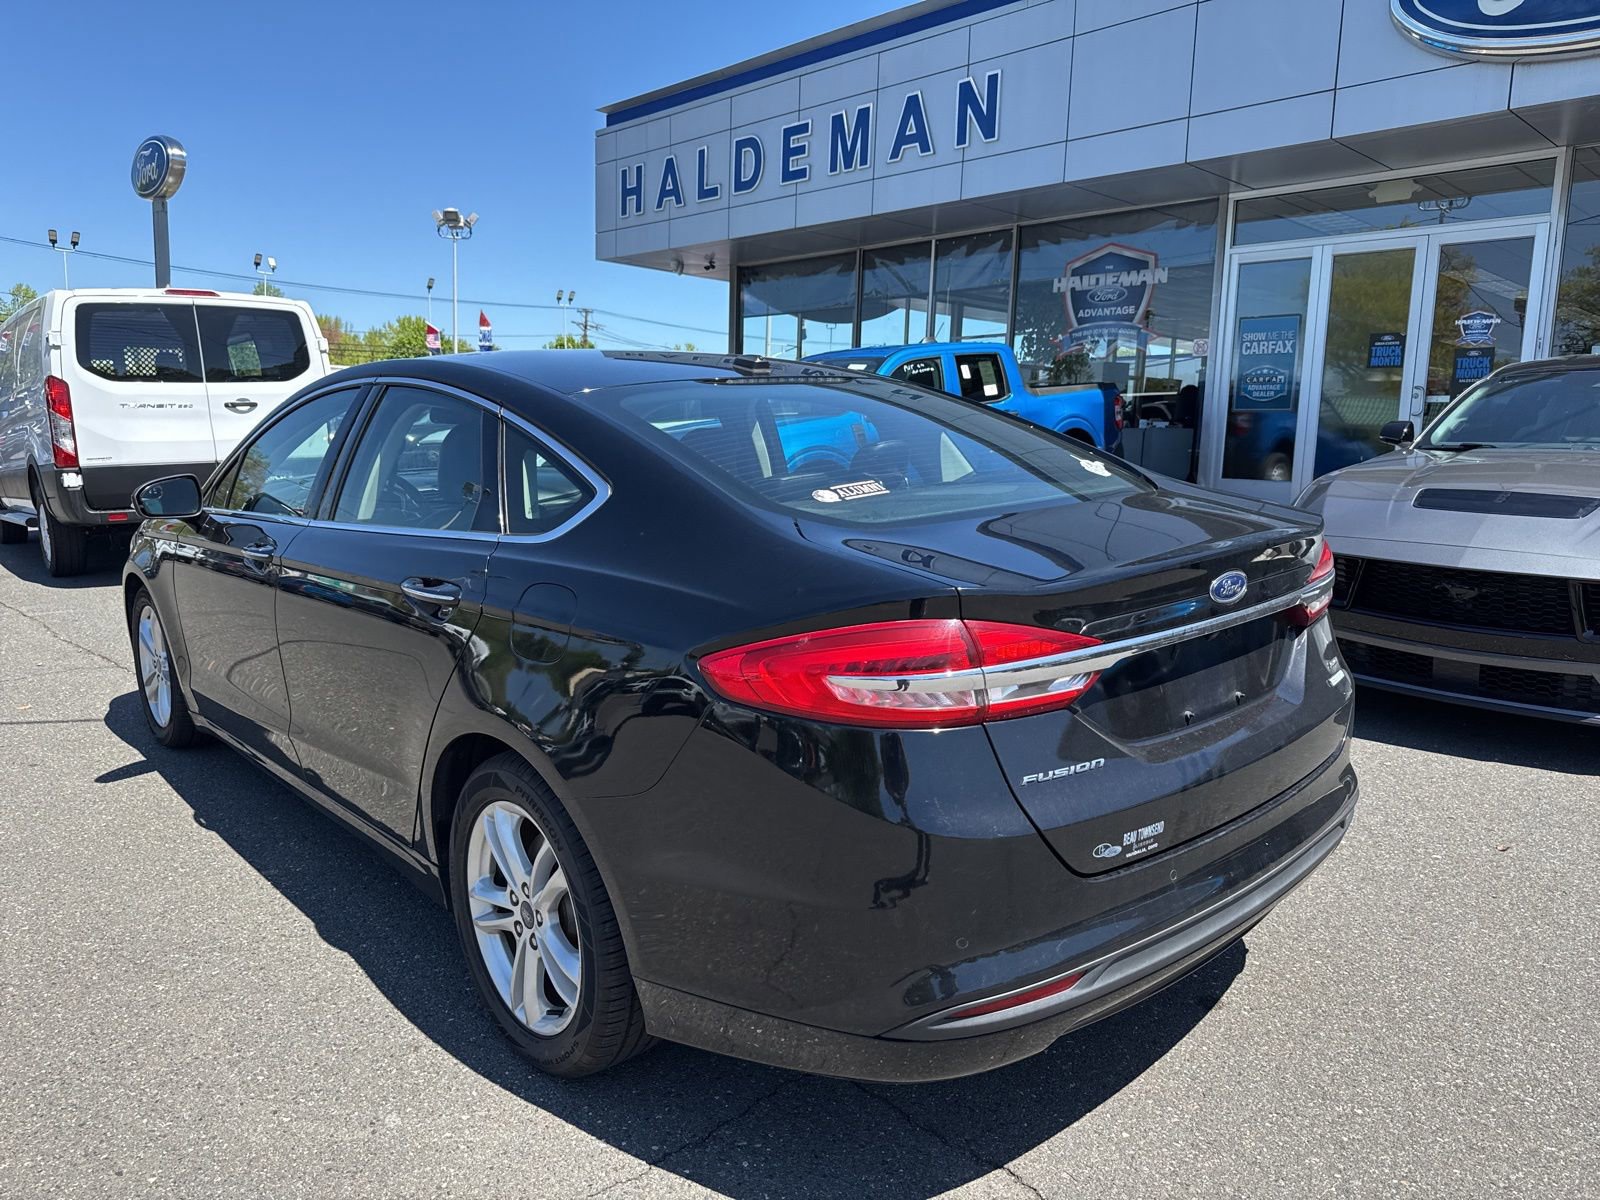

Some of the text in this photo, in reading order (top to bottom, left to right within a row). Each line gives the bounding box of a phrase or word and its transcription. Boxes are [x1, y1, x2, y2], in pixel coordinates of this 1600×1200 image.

[619, 69, 1002, 218] HALDEMAN
[136, 148, 158, 188] Ford
[1053, 267, 1168, 293] HALDEMAN
[1094, 288, 1120, 301] Ford
[1078, 305, 1135, 318] ADVANTAGE
[1242, 330, 1295, 341] SHOW ME THE
[1242, 340, 1294, 355] CARFAX
[1371, 346, 1402, 357] TRUCK
[1370, 356, 1401, 367] MONTH
[1456, 356, 1491, 368] TRUCK
[1456, 368, 1490, 379] MONTH
[837, 482, 886, 498] ALUMNI
[1220, 579, 1242, 597] Ford
[1021, 758, 1105, 786] FUSION
